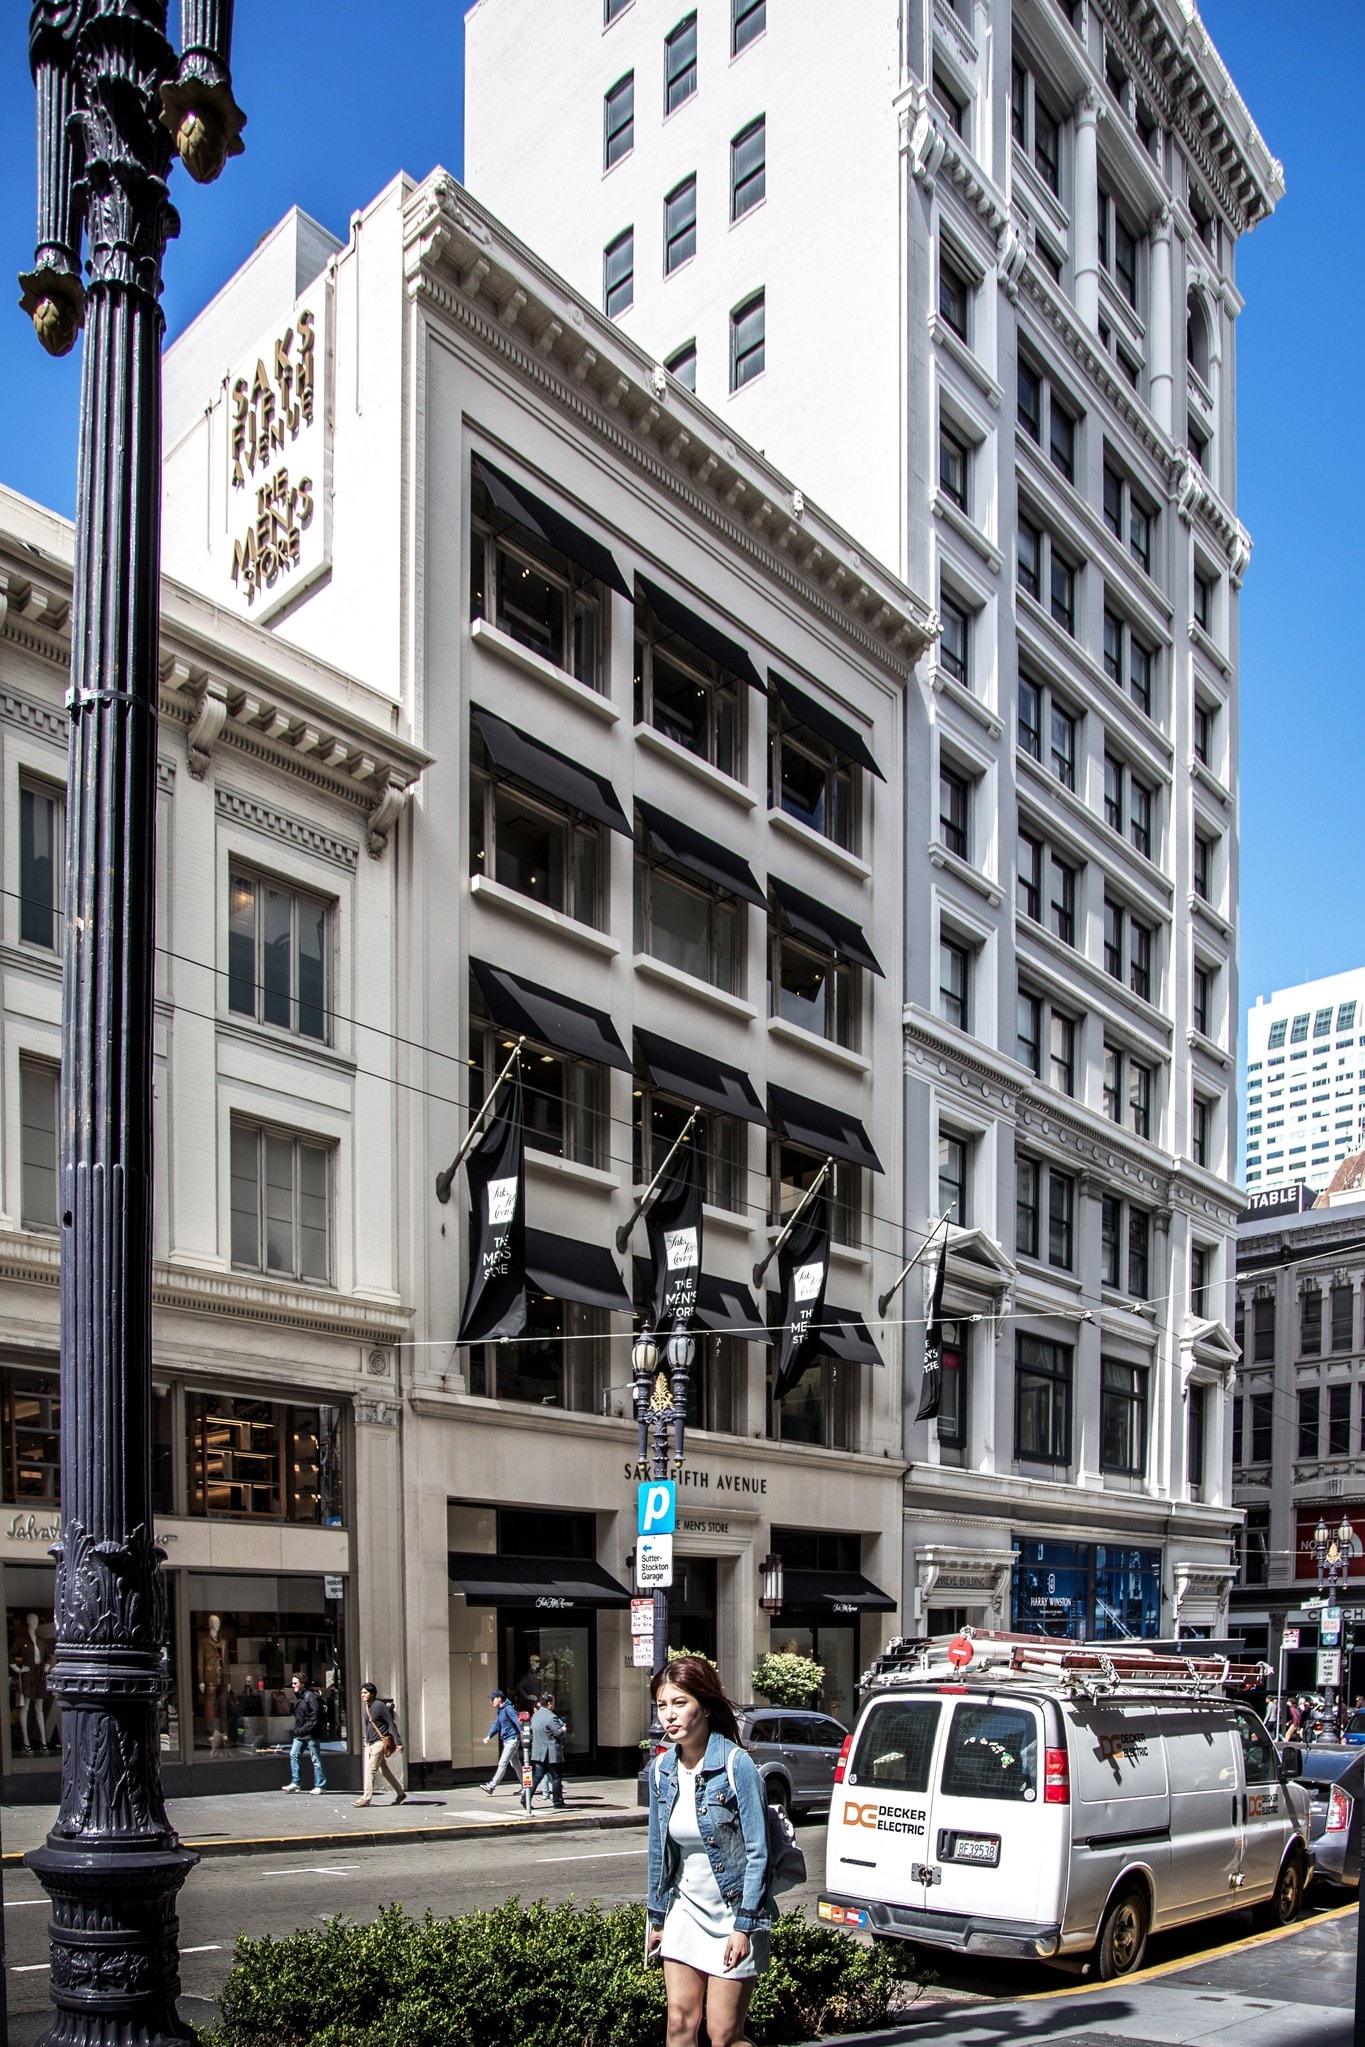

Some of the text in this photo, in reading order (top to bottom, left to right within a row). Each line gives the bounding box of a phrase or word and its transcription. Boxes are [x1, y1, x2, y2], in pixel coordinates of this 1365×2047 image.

[232, 309, 314, 421] SAKS
[232, 352, 314, 461] FIFTH
[232, 389, 314, 489] AVENUE
[255, 467, 289, 516] THE
[231, 476, 314, 590] MEN'S
[243, 527, 300, 604] STORE
[674, 1279, 693, 1291] THE
[665, 1291, 697, 1306] MEN'S
[667, 1307, 695, 1318] STORE
[800, 1309, 814, 1319] TH
[624, 1463, 767, 1494] SAK FIFTH AVENUE
[683, 1520, 706, 1533] MEN'S
[708, 1522, 729, 1533] STORE
[641, 1555, 662, 1563] Sutter-
[641, 1563, 669, 1571] Stockton
[641, 1572, 664, 1581] Garage
[1031, 1597, 1072, 1607] HARRY WINSTON
[1121, 1733, 1146, 1744] DECKER
[1123, 1746, 1149, 1758] ELECTRIC
[1262, 1794, 1278, 1803] DECKER
[879, 1805, 926, 1822] DECKER
[877, 1819, 925, 1836] ELECTRIC
[959, 1842, 996, 1858] 8F39538
